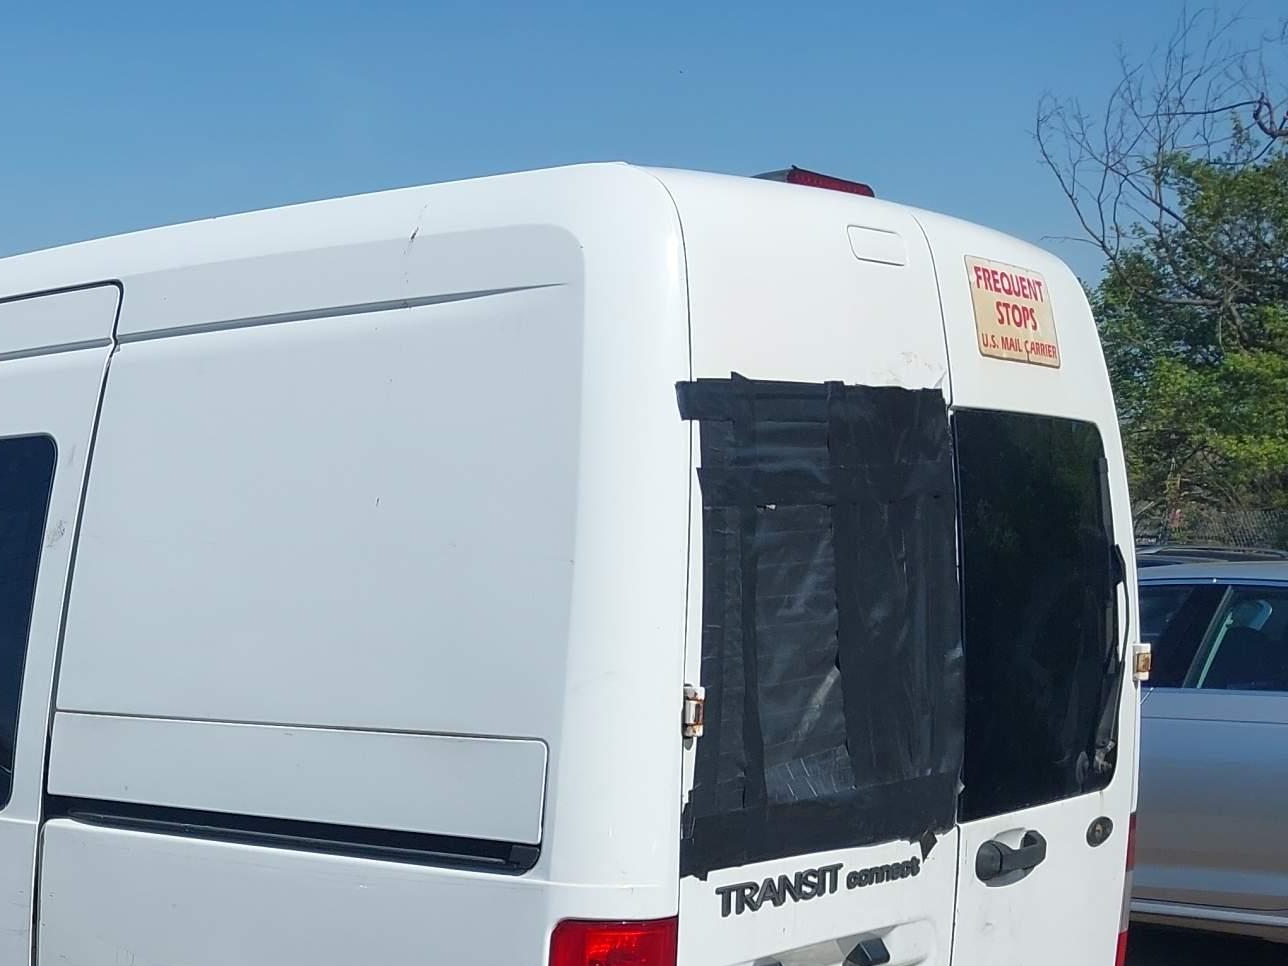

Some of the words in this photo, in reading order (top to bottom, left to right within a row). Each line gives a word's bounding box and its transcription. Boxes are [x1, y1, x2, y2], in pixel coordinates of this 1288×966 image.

[973, 265, 1044, 302] FREQUENT
[996, 301, 1038, 331] STOPS
[981, 333, 999, 349] U.S.
[1000, 336, 1023, 352] MAIL
[1024, 340, 1057, 358] CARRIER
[715, 863, 844, 918] TRANSIT
[846, 856, 921, 889] connect
